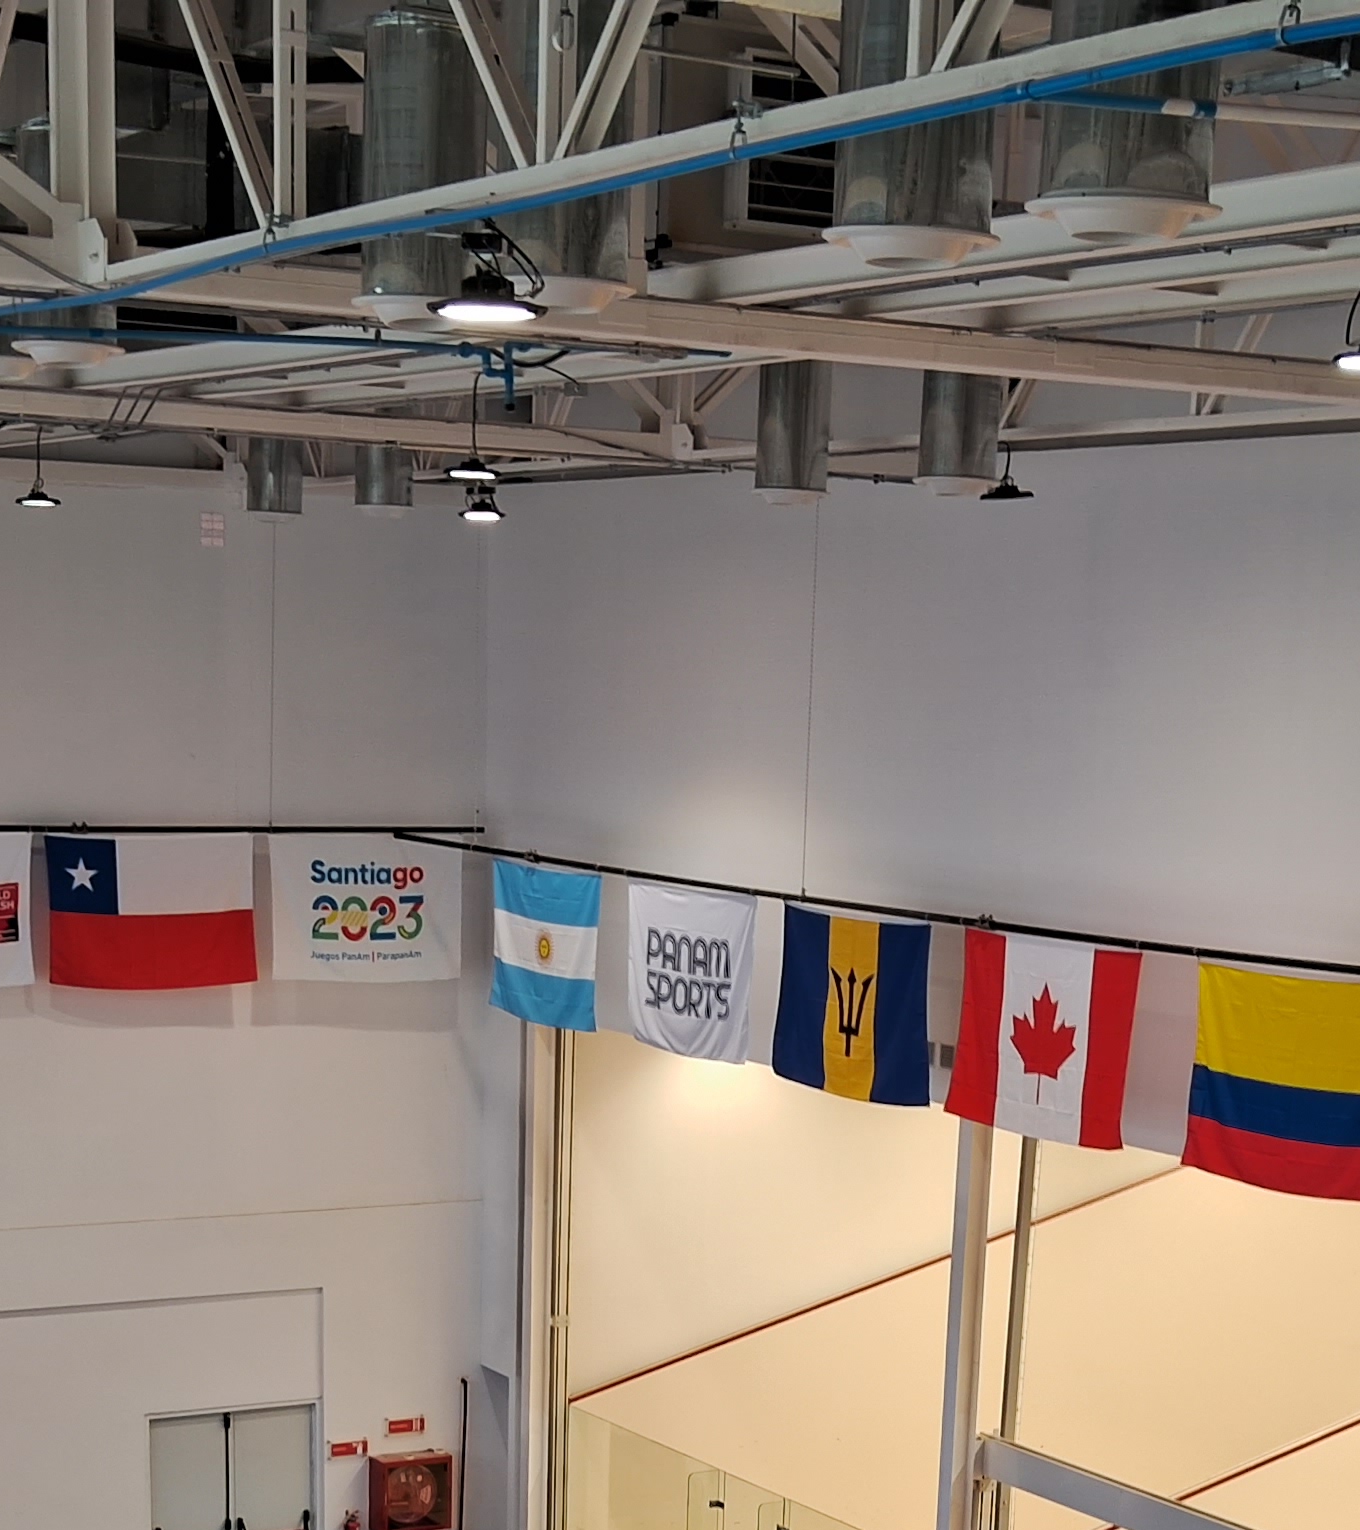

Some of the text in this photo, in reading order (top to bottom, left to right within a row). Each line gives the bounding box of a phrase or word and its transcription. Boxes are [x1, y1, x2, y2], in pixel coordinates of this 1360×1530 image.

[310, 859, 424, 890] Santiago
[312, 895, 424, 942] 2023
[310, 949, 422, 962] Juegos PanAm ParapanAm
[646, 926, 731, 979] PANAM
[644, 968, 732, 1022] SPORTS
